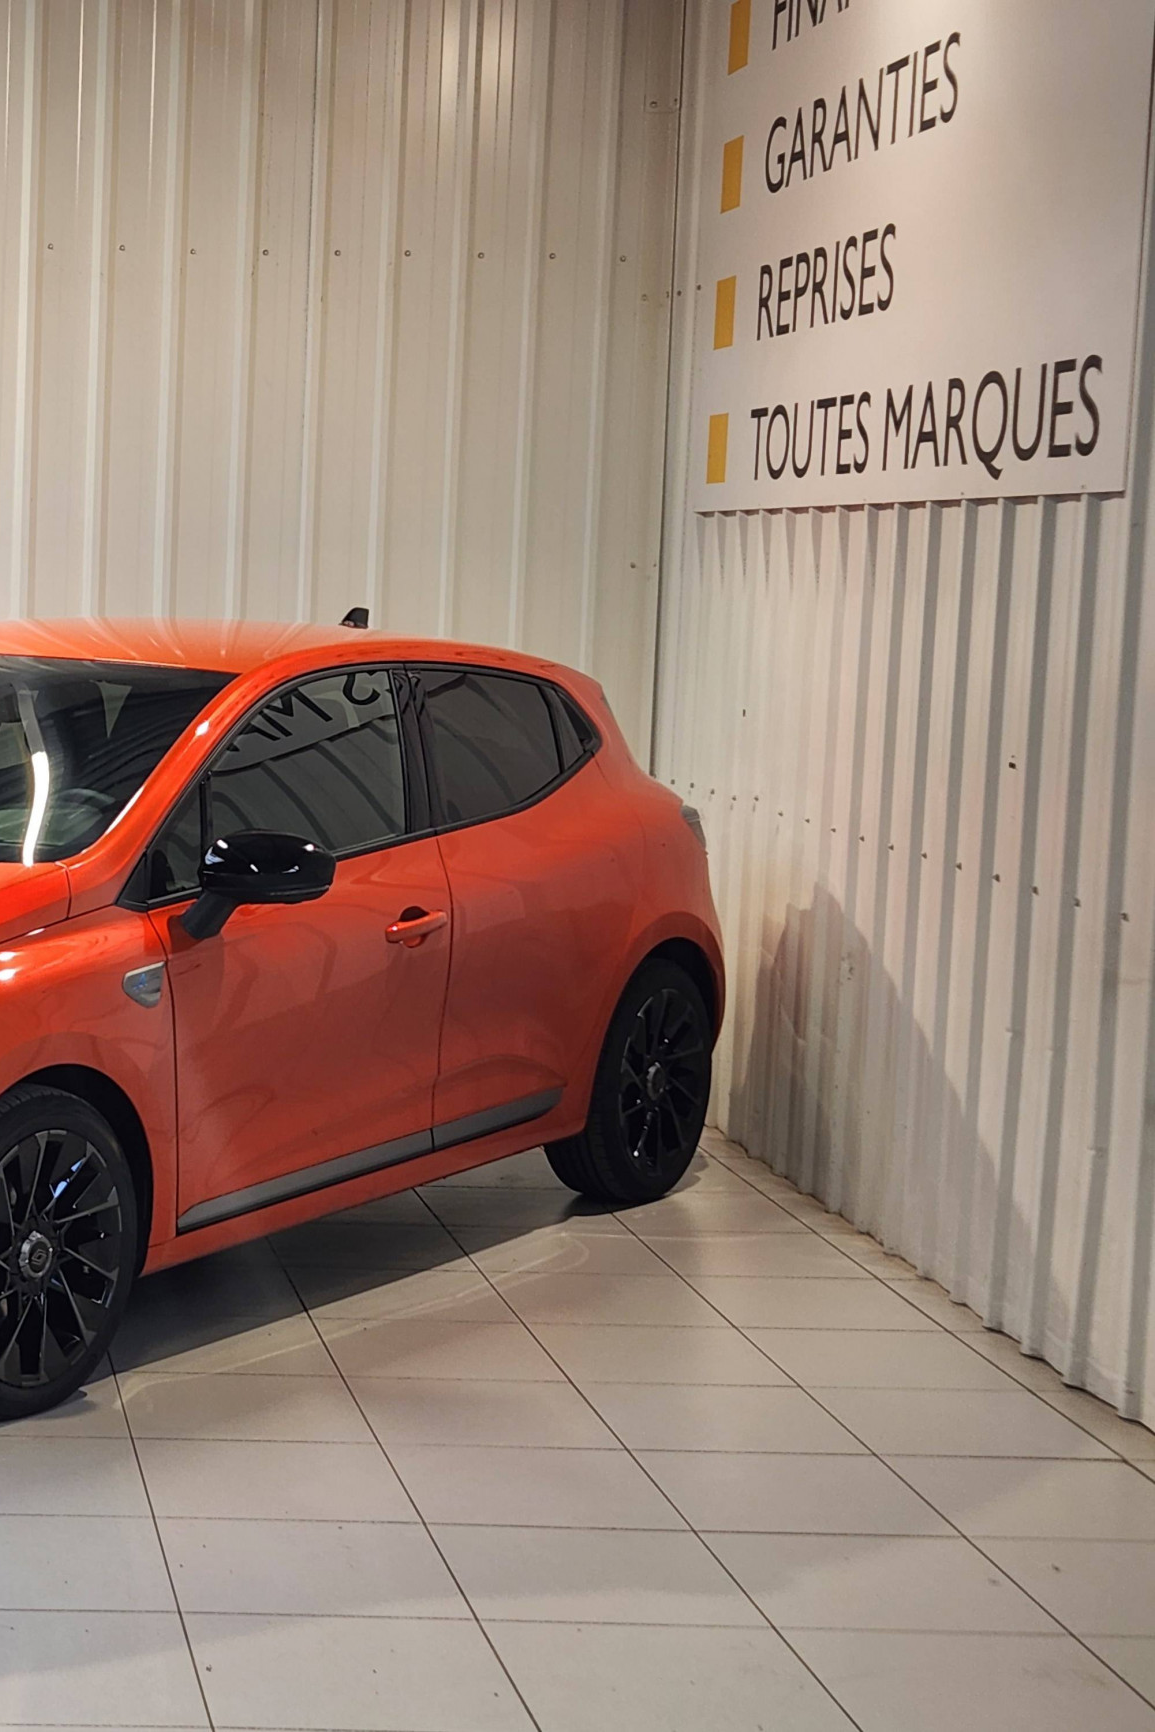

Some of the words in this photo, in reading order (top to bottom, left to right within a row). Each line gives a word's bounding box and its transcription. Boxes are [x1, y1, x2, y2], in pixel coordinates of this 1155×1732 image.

[765, 32, 961, 194] GARANTIES
[756, 223, 896, 341] REPRISES
[750, 391, 871, 481] TOUTES
[882, 354, 1103, 481] MARQUES
